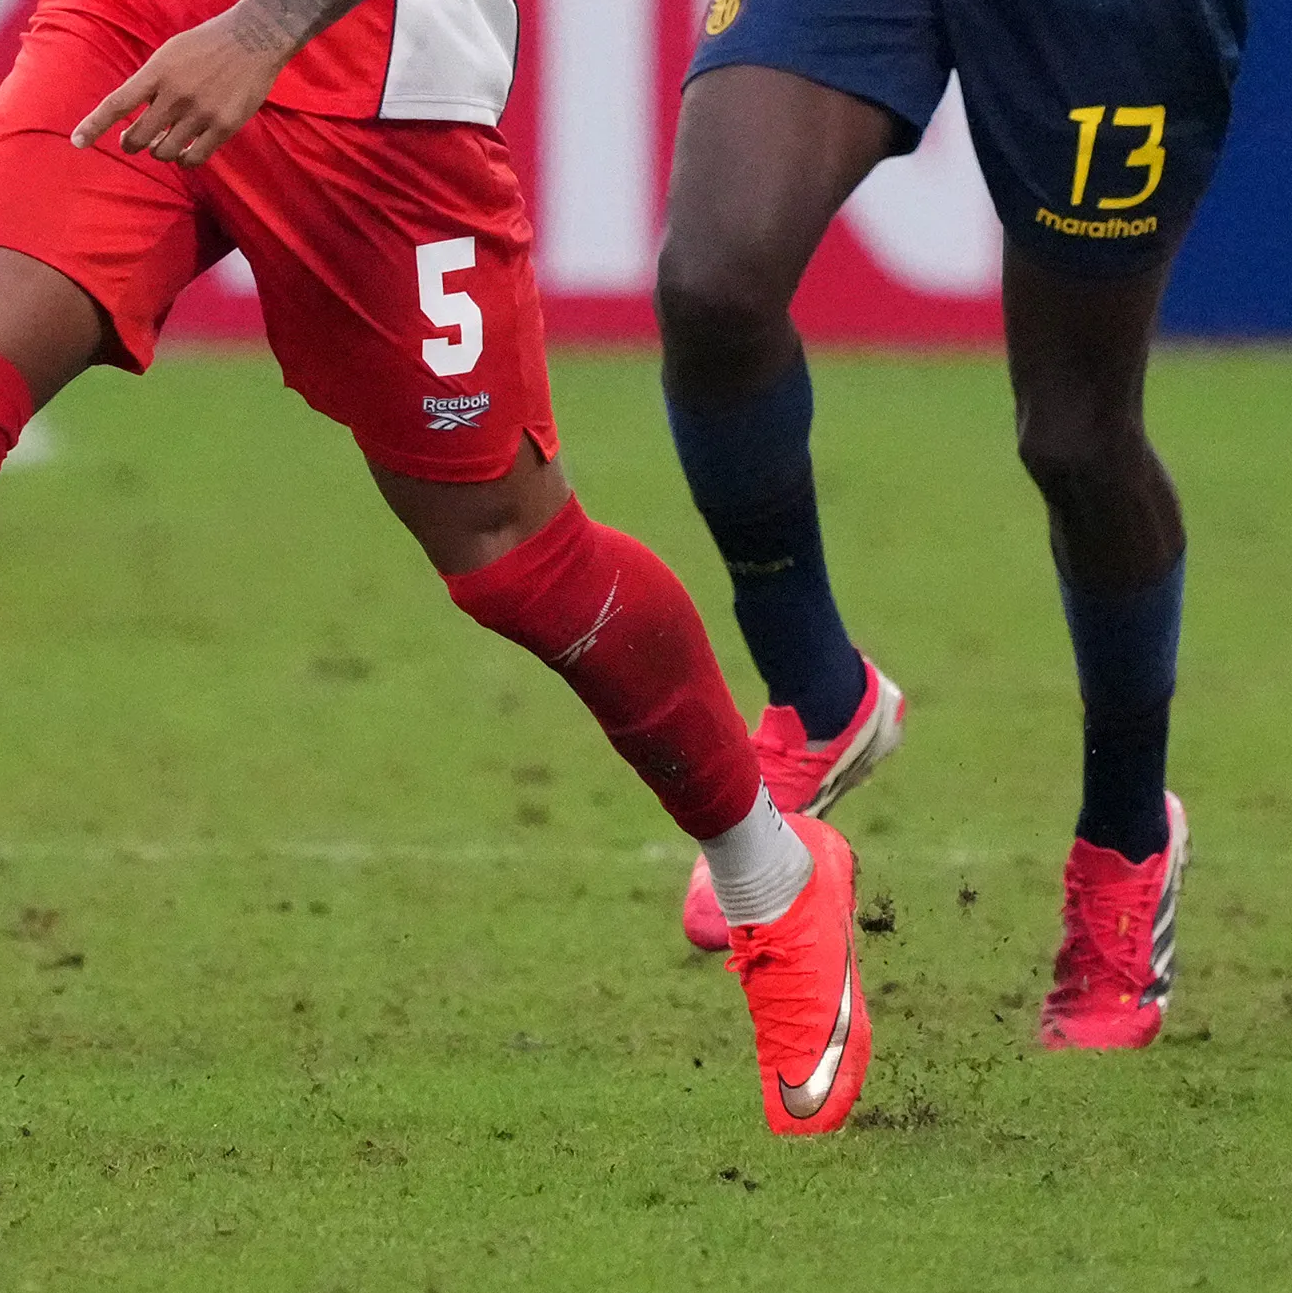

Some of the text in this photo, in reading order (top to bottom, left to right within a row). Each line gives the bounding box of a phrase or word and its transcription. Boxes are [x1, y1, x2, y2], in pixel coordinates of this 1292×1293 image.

[1068, 104, 1166, 209] 13
[1035, 207, 1158, 239] marathon
[415, 236, 484, 377] 5
[422, 391, 490, 412] Reebok
